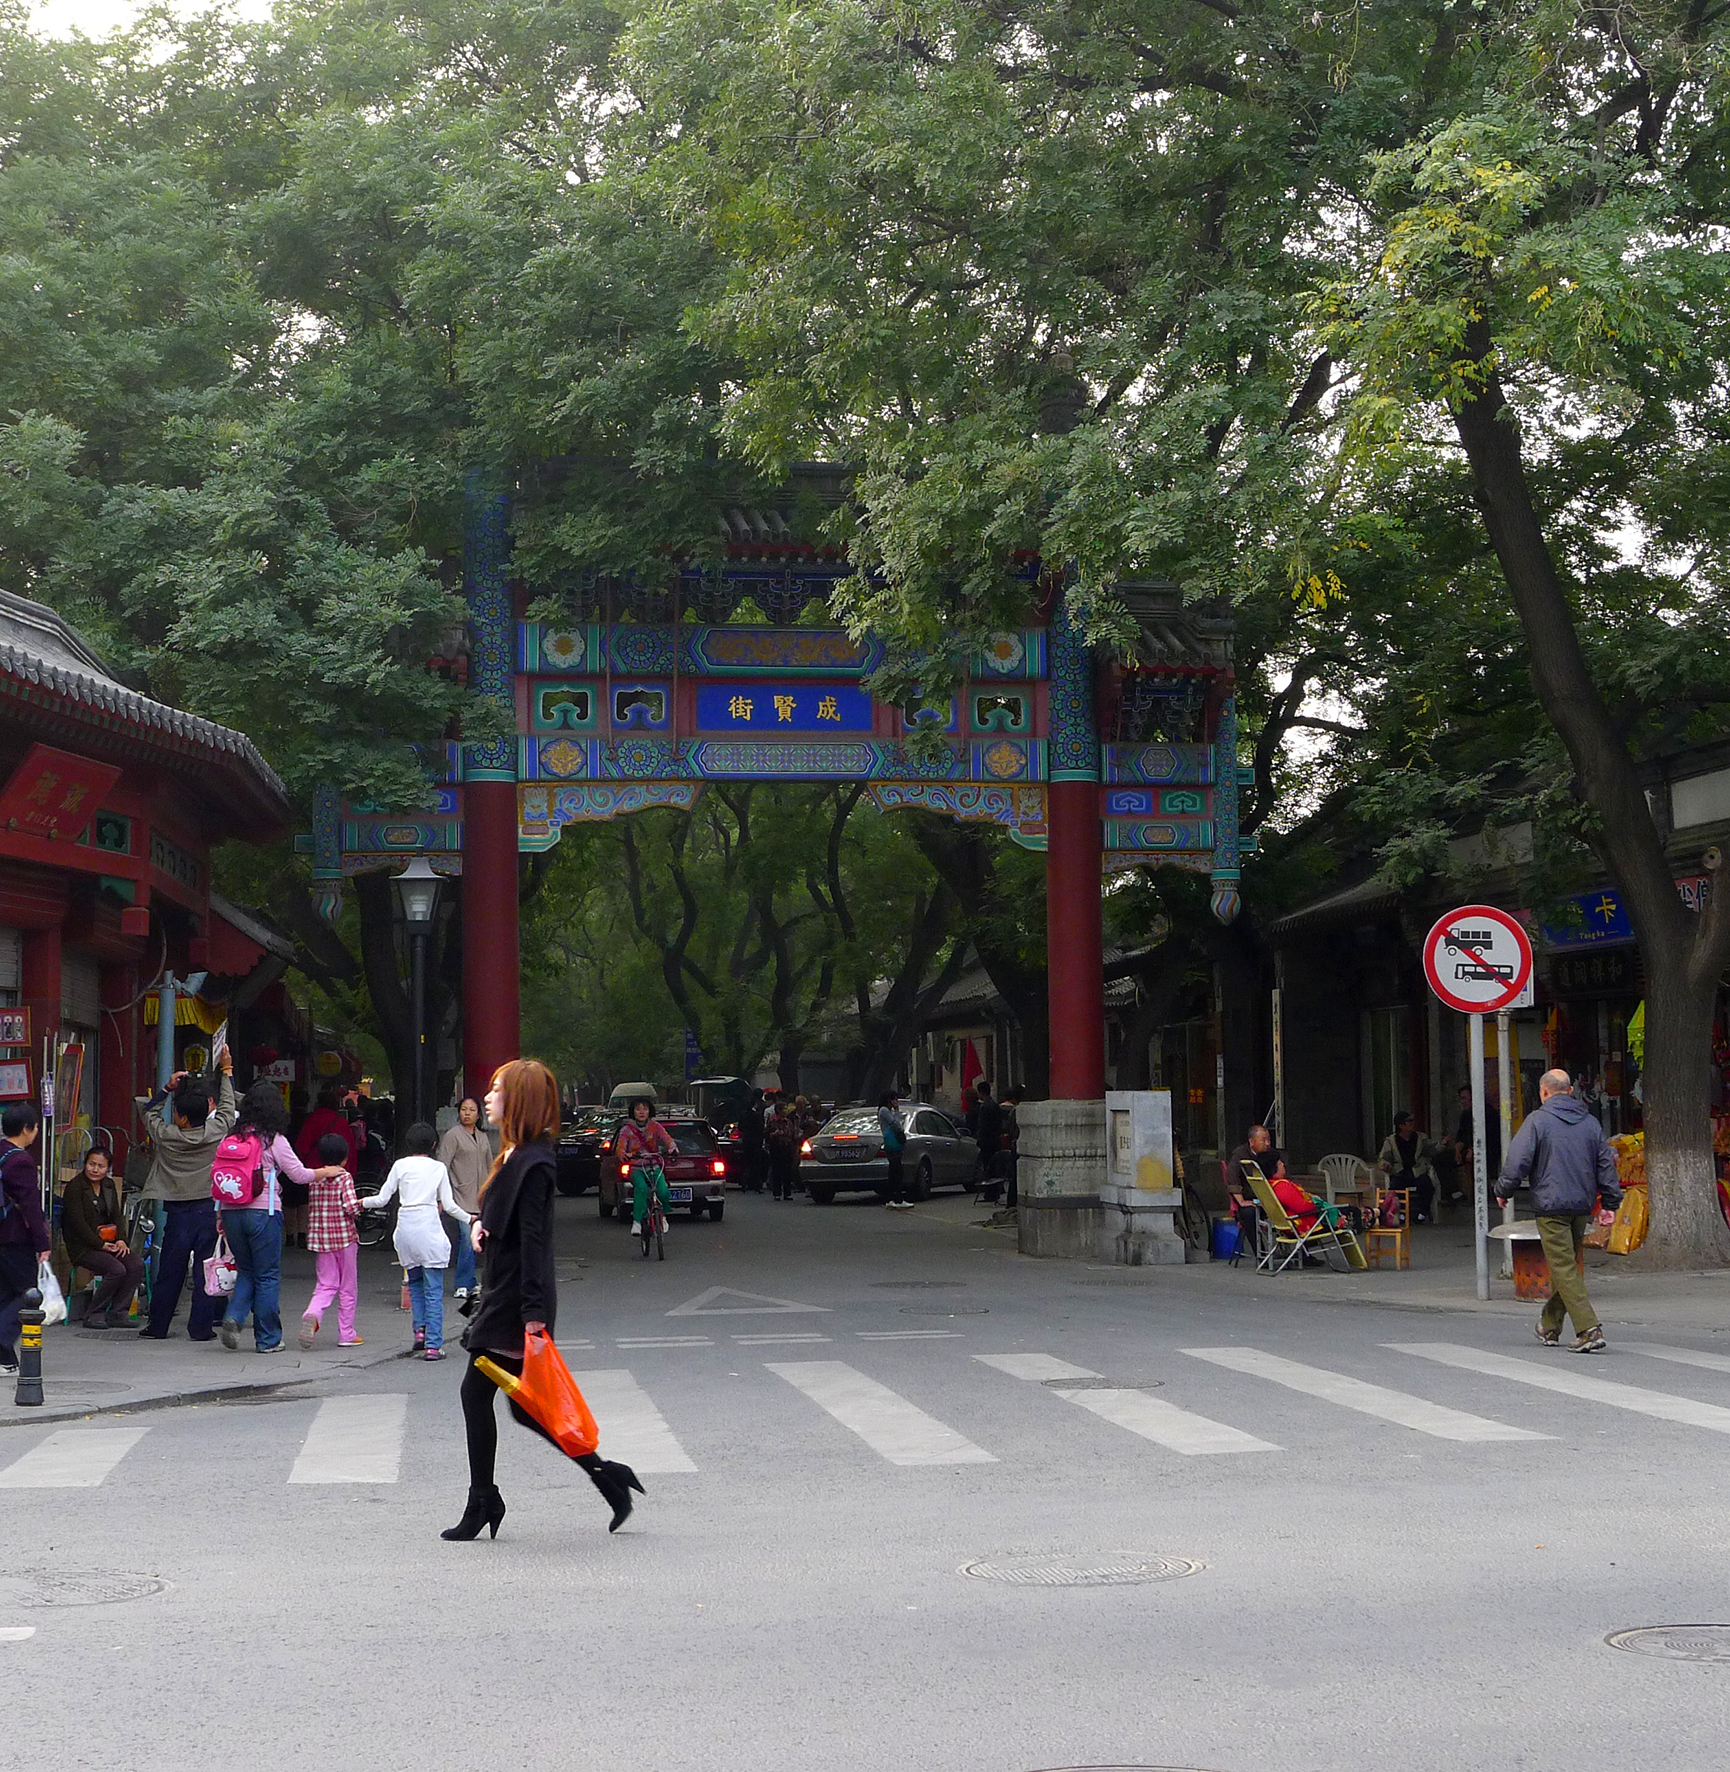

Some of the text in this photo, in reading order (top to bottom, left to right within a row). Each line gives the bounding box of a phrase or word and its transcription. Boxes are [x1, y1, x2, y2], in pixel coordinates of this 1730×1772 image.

[727, 695, 842, 722] 成賢街
[1578, 930, 1606, 941] Tangka
